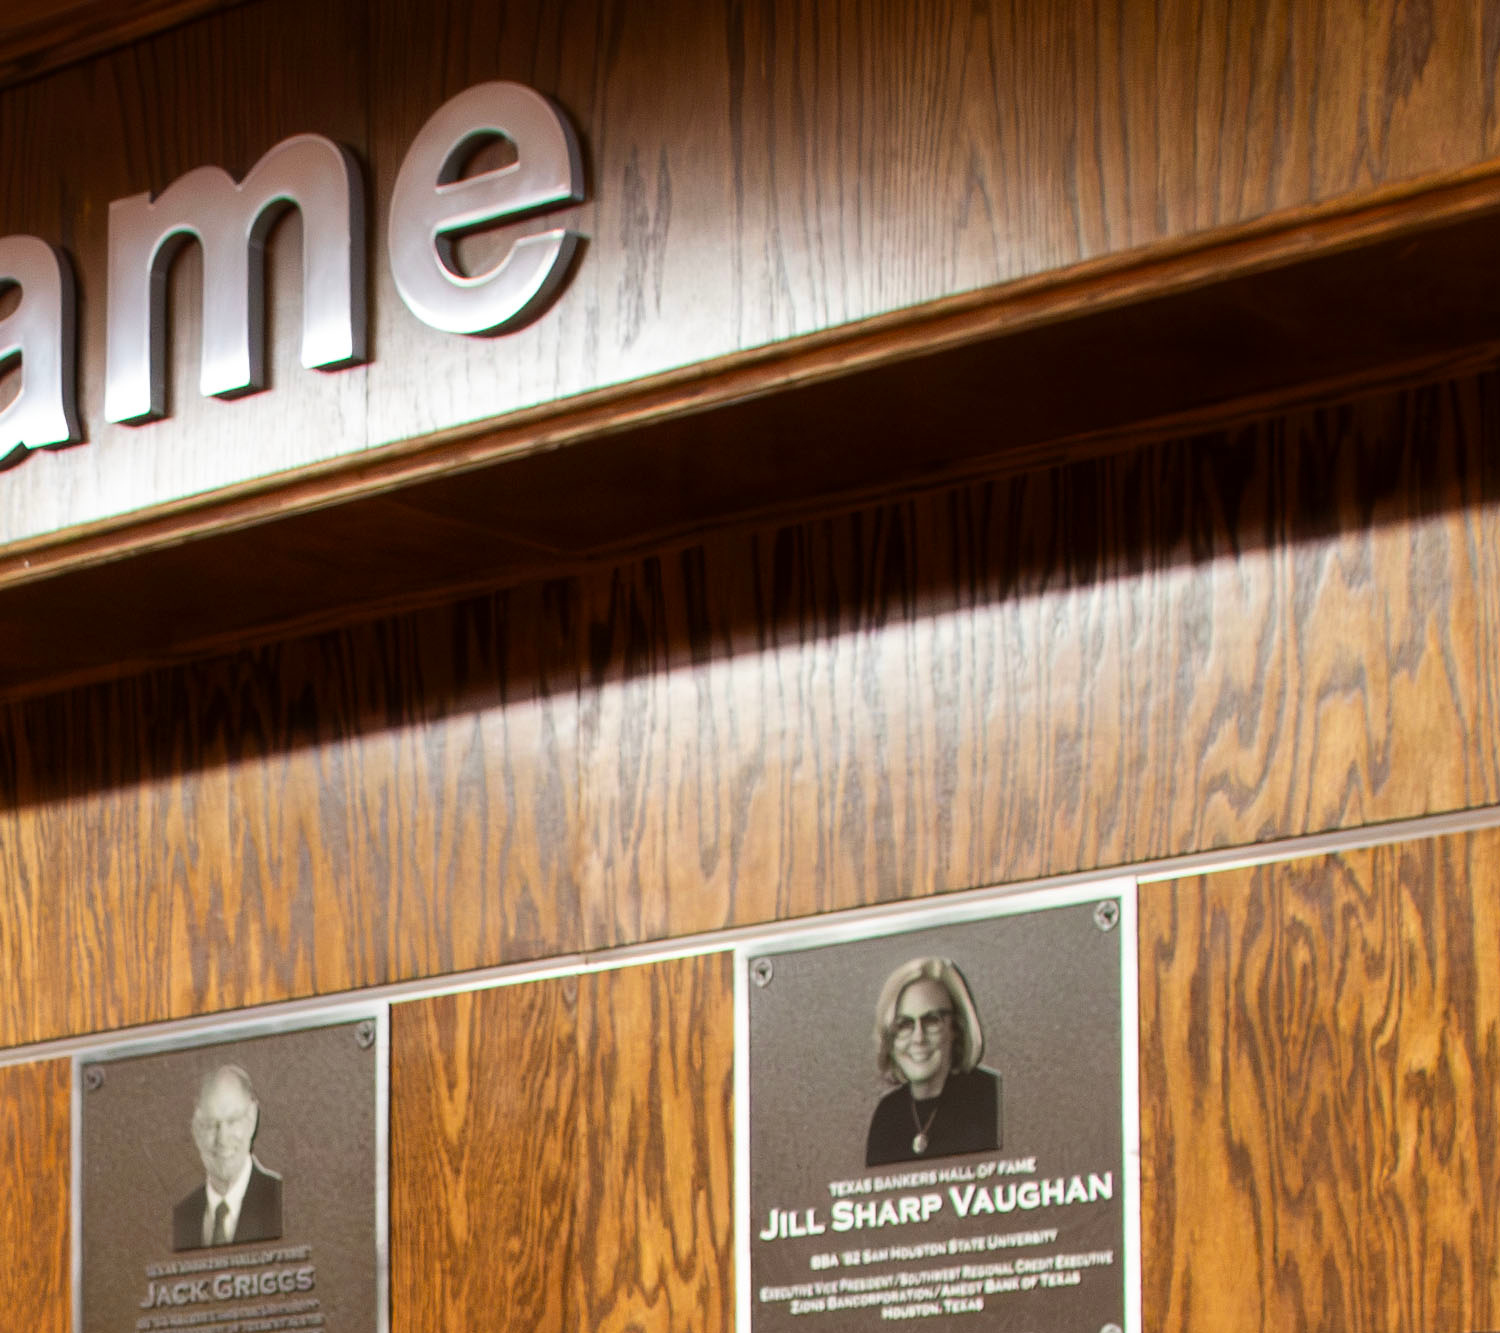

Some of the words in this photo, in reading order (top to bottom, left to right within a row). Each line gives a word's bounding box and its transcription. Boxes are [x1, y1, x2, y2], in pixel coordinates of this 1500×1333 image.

[758, 1207, 825, 1240] JILL
[831, 1192, 942, 1231] SHARP
[948, 1171, 1112, 1217] VAUGHAN
